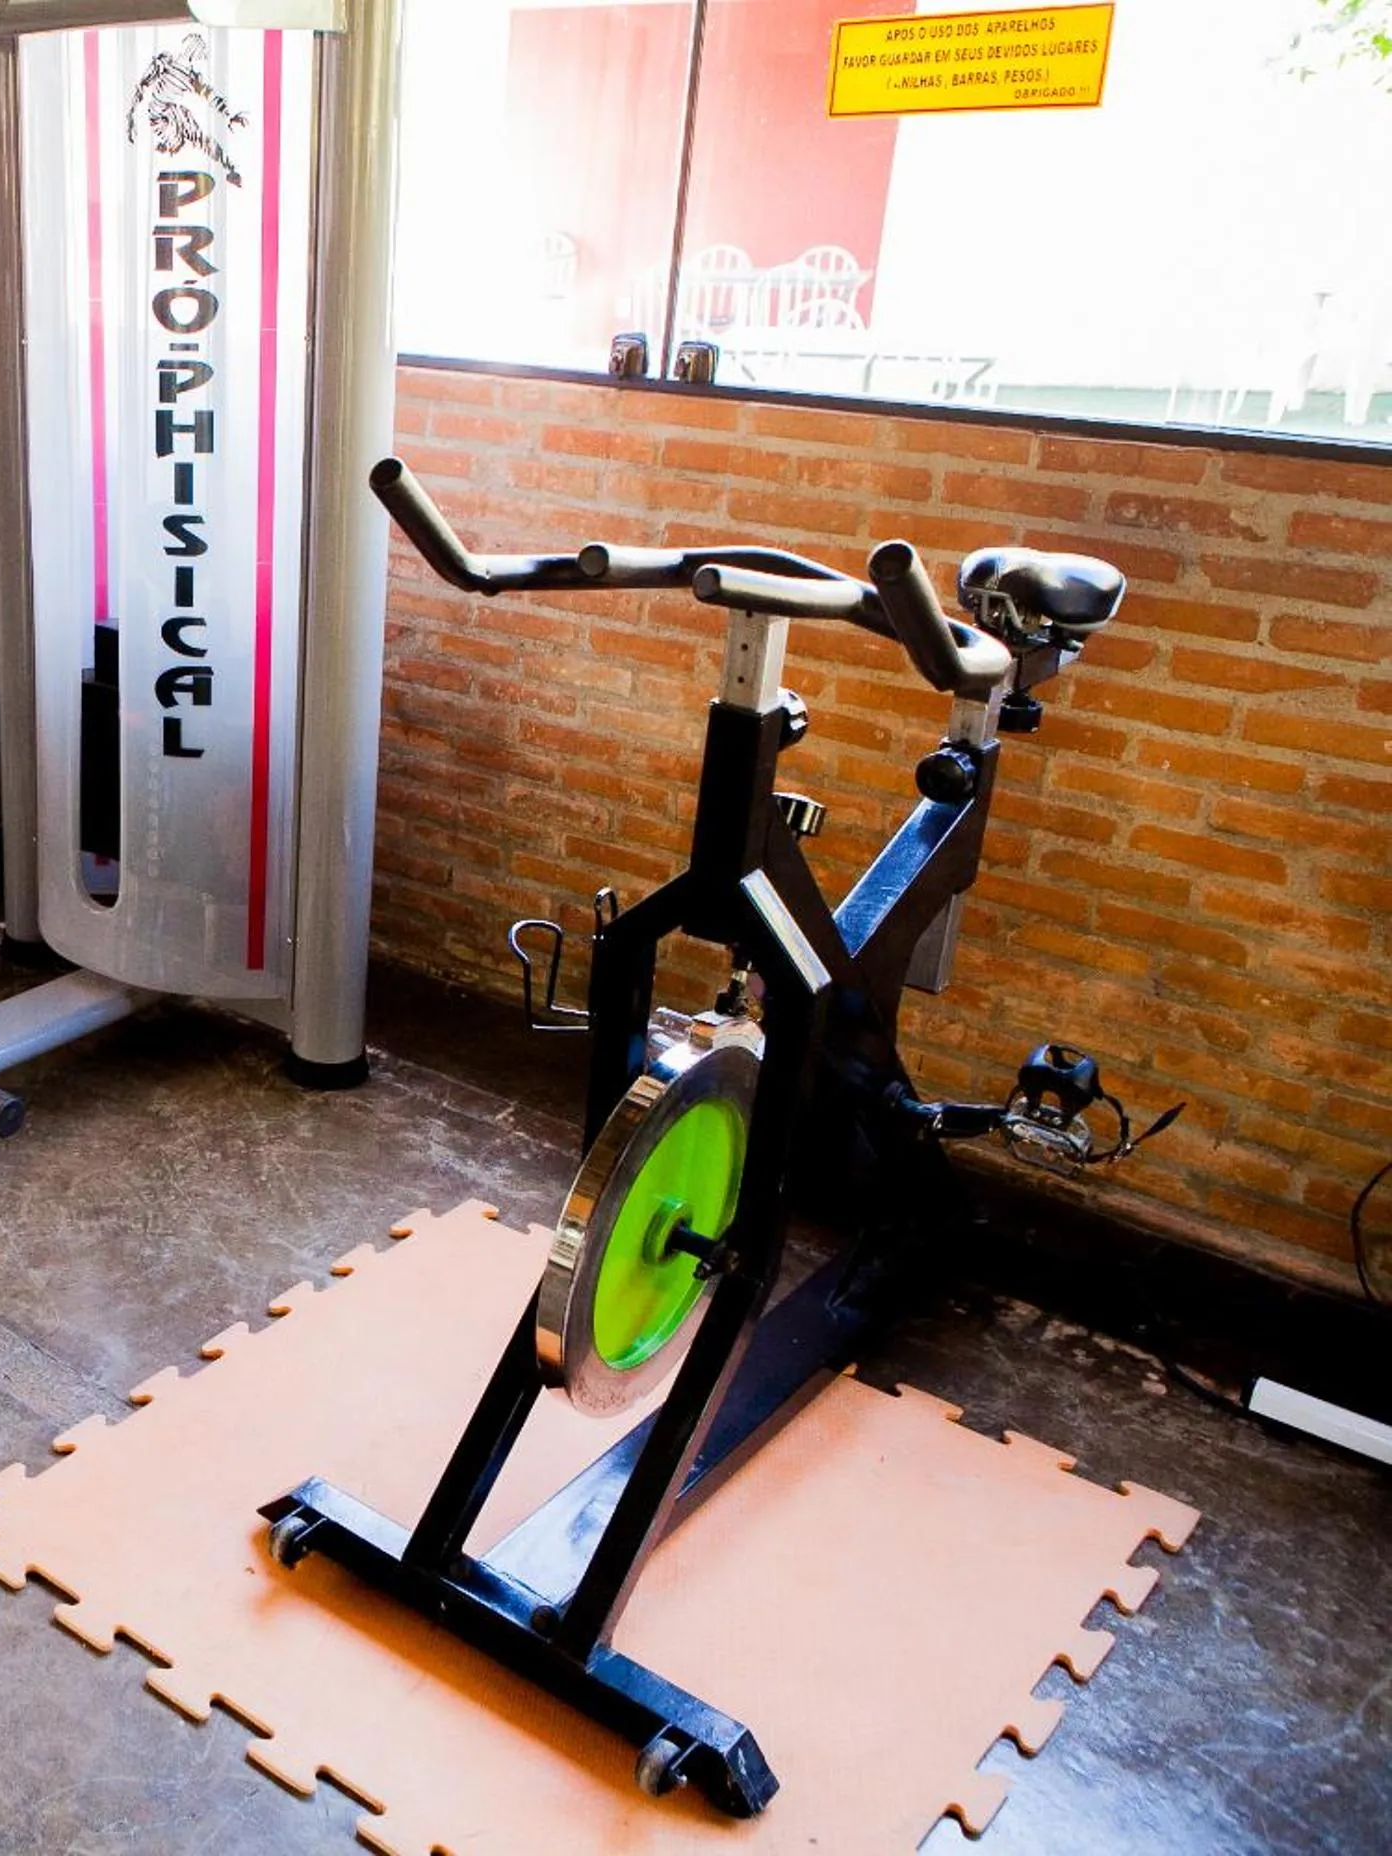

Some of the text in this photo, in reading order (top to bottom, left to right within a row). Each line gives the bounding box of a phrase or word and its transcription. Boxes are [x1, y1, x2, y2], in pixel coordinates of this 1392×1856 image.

[918, 25, 927, 40] O
[930, 24, 952, 39] USO
[956, 22, 979, 37] DOS
[987, 17, 1055, 34] APARELHOS
[843, 39, 1098, 69] FAVOR GUARDAR EM SEUS DEVIDOS LUGARES
